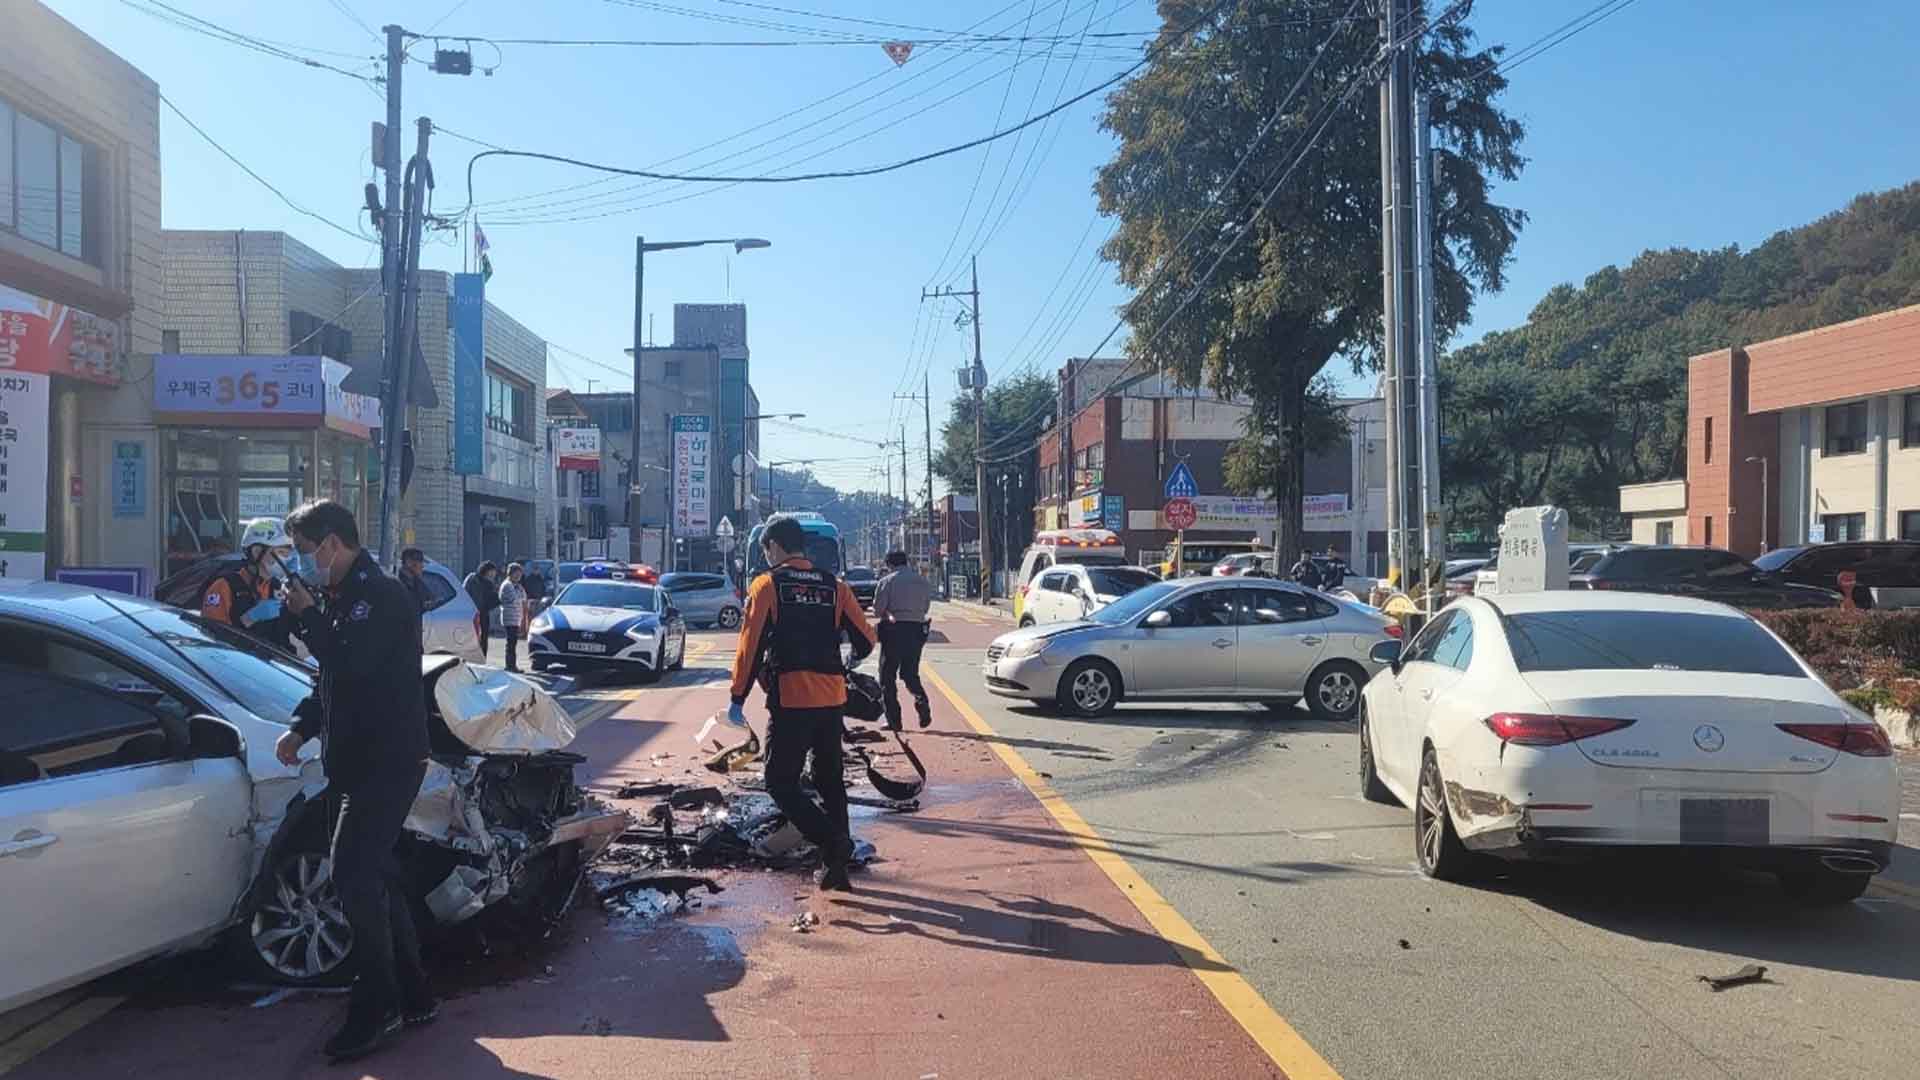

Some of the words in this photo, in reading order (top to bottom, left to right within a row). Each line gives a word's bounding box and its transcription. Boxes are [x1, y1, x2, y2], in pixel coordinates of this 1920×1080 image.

[167, 381, 211, 397] 우체국
[216, 369, 281, 409] 365
[288, 383, 313, 399] 코너
[1168, 503, 1193, 514] 정지
